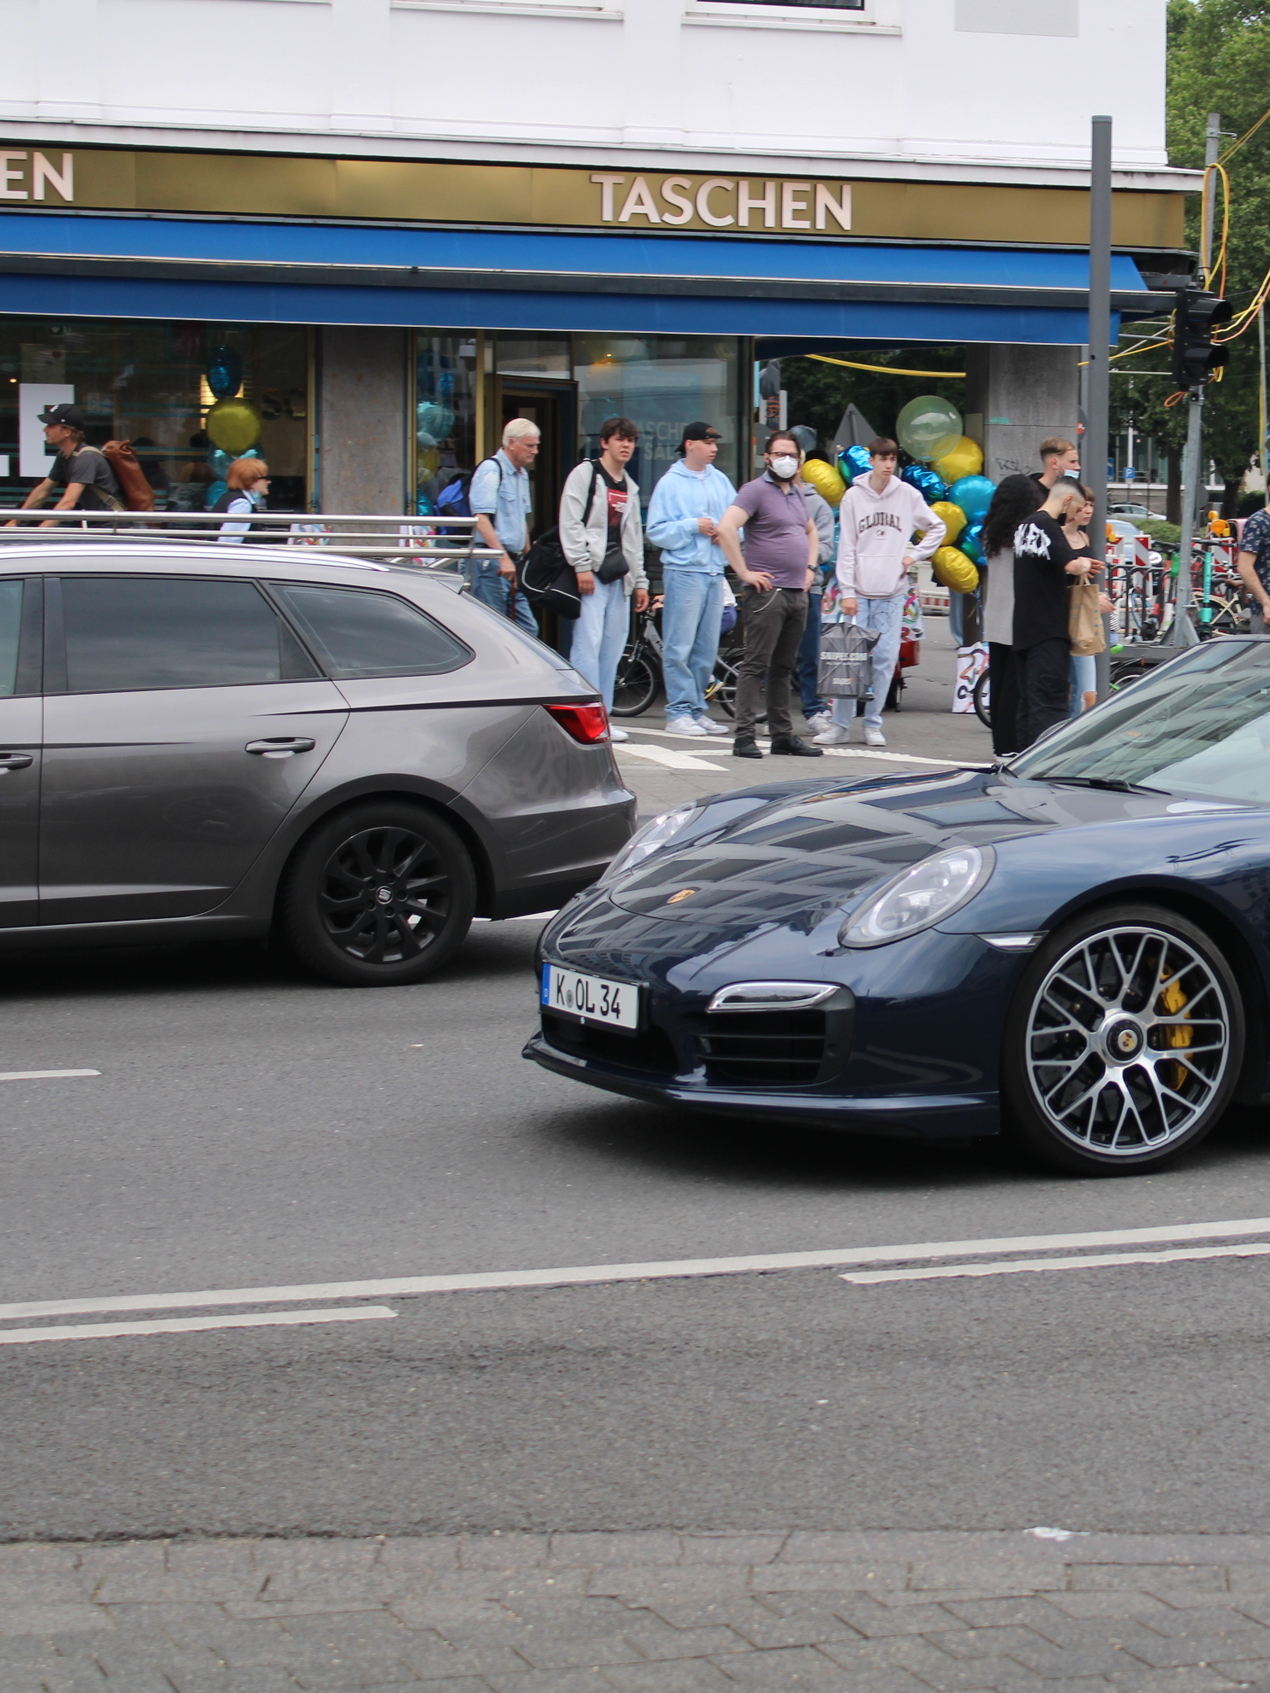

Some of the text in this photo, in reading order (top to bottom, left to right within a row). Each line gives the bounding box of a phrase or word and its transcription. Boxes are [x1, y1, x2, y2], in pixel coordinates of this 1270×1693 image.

[590, 173, 853, 231] TASCHEN
[556, 973, 621, 1020] K OL 34
